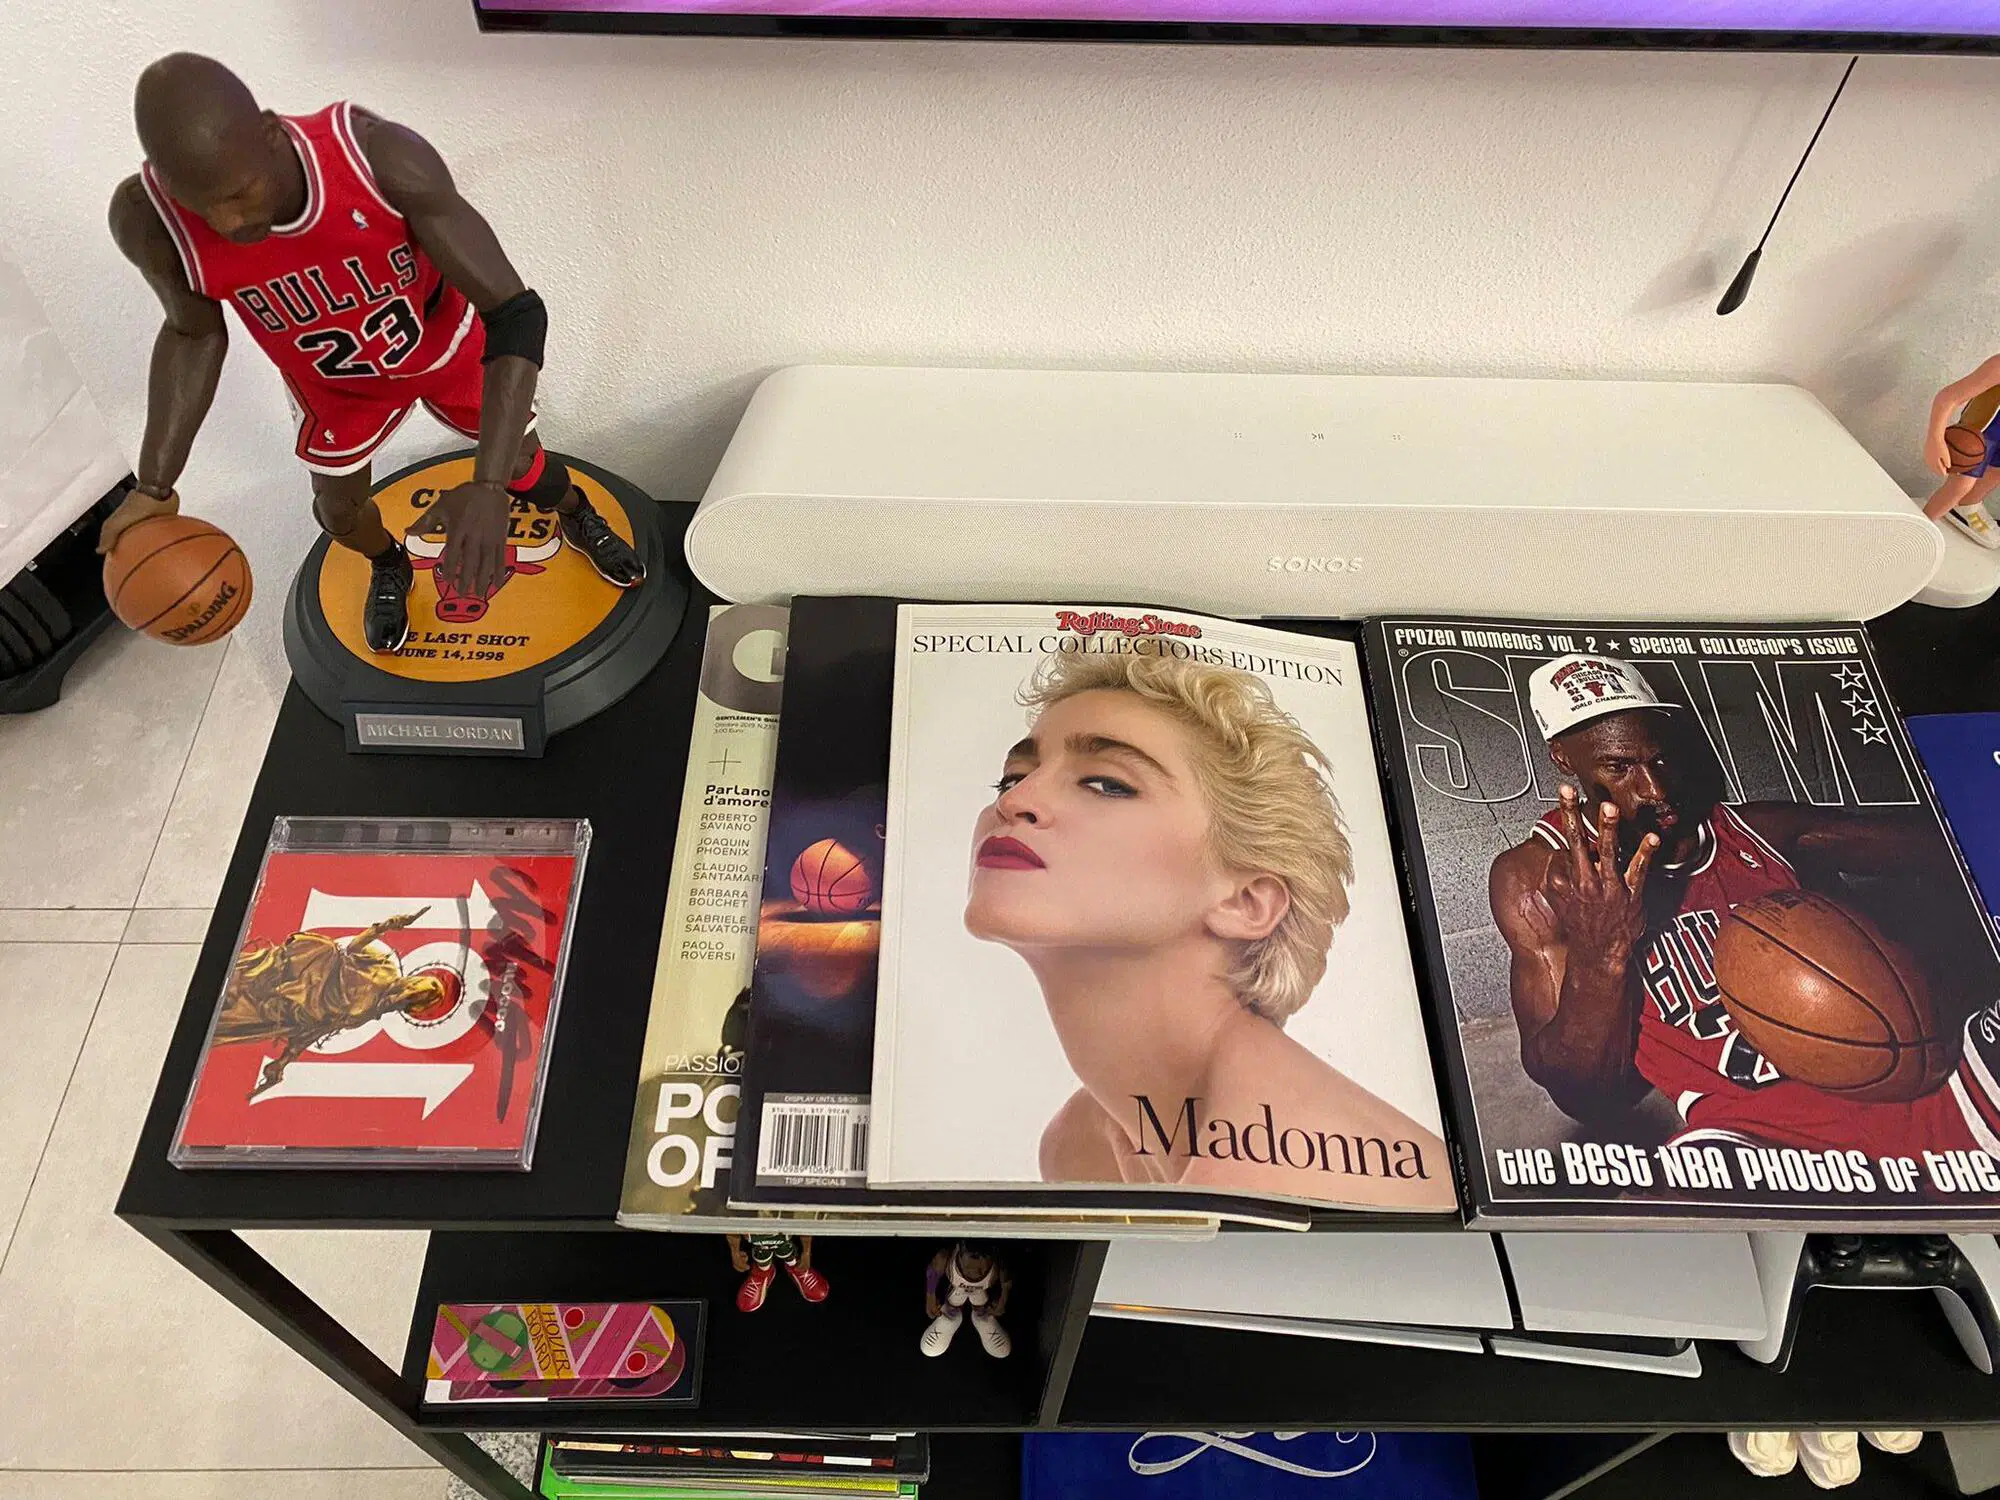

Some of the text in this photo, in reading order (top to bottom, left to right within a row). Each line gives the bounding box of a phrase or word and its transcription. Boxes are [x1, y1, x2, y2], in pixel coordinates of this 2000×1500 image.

[234, 241, 418, 333] BULLS
[293, 295, 424, 378] 23
[1266, 556, 1363, 574] SONOS
[161, 580, 237, 641] SPALDING
[1056, 611, 1141, 636] Rolling
[424, 631, 472, 645] LAST
[476, 634, 530, 647] SHOT
[1548, 635, 1583, 653] VOL.
[1588, 637, 1599, 653] 2
[394, 648, 437, 658] JUNE
[913, 634, 1343, 687] SPECIAL COLLECTORS EDITION
[1570, 700, 1593, 712] WORLD
[367, 724, 513, 740] MICHAEL JORDAN
[705, 784, 770, 797] Parlano
[701, 812, 758, 823] ROBERTO
[699, 821, 752, 832] SAVIANO
[697, 837, 750, 848] JOAQUIN
[696, 846, 749, 857] PHOENIX
[693, 862, 748, 873] CLAUDIO
[690, 887, 749, 898] BARBARA
[688, 897, 749, 908] BOUCHET
[686, 914, 747, 925] GABRIELE
[684, 923, 756, 935] SALVATORE
[682, 940, 724, 950] PAOLO
[680, 950, 736, 961] ROVERSI
[784, 1095, 814, 1103] DISPLAY
[1128, 1094, 1432, 1180] Madonna
[1657, 1144, 1734, 1190] NBA
[1879, 1156, 1920, 1193] OF
[804, 1177, 847, 1187] SPECIALS
[526, 1308, 552, 1372] BOARD
[542, 1311, 571, 1376] HOVER
